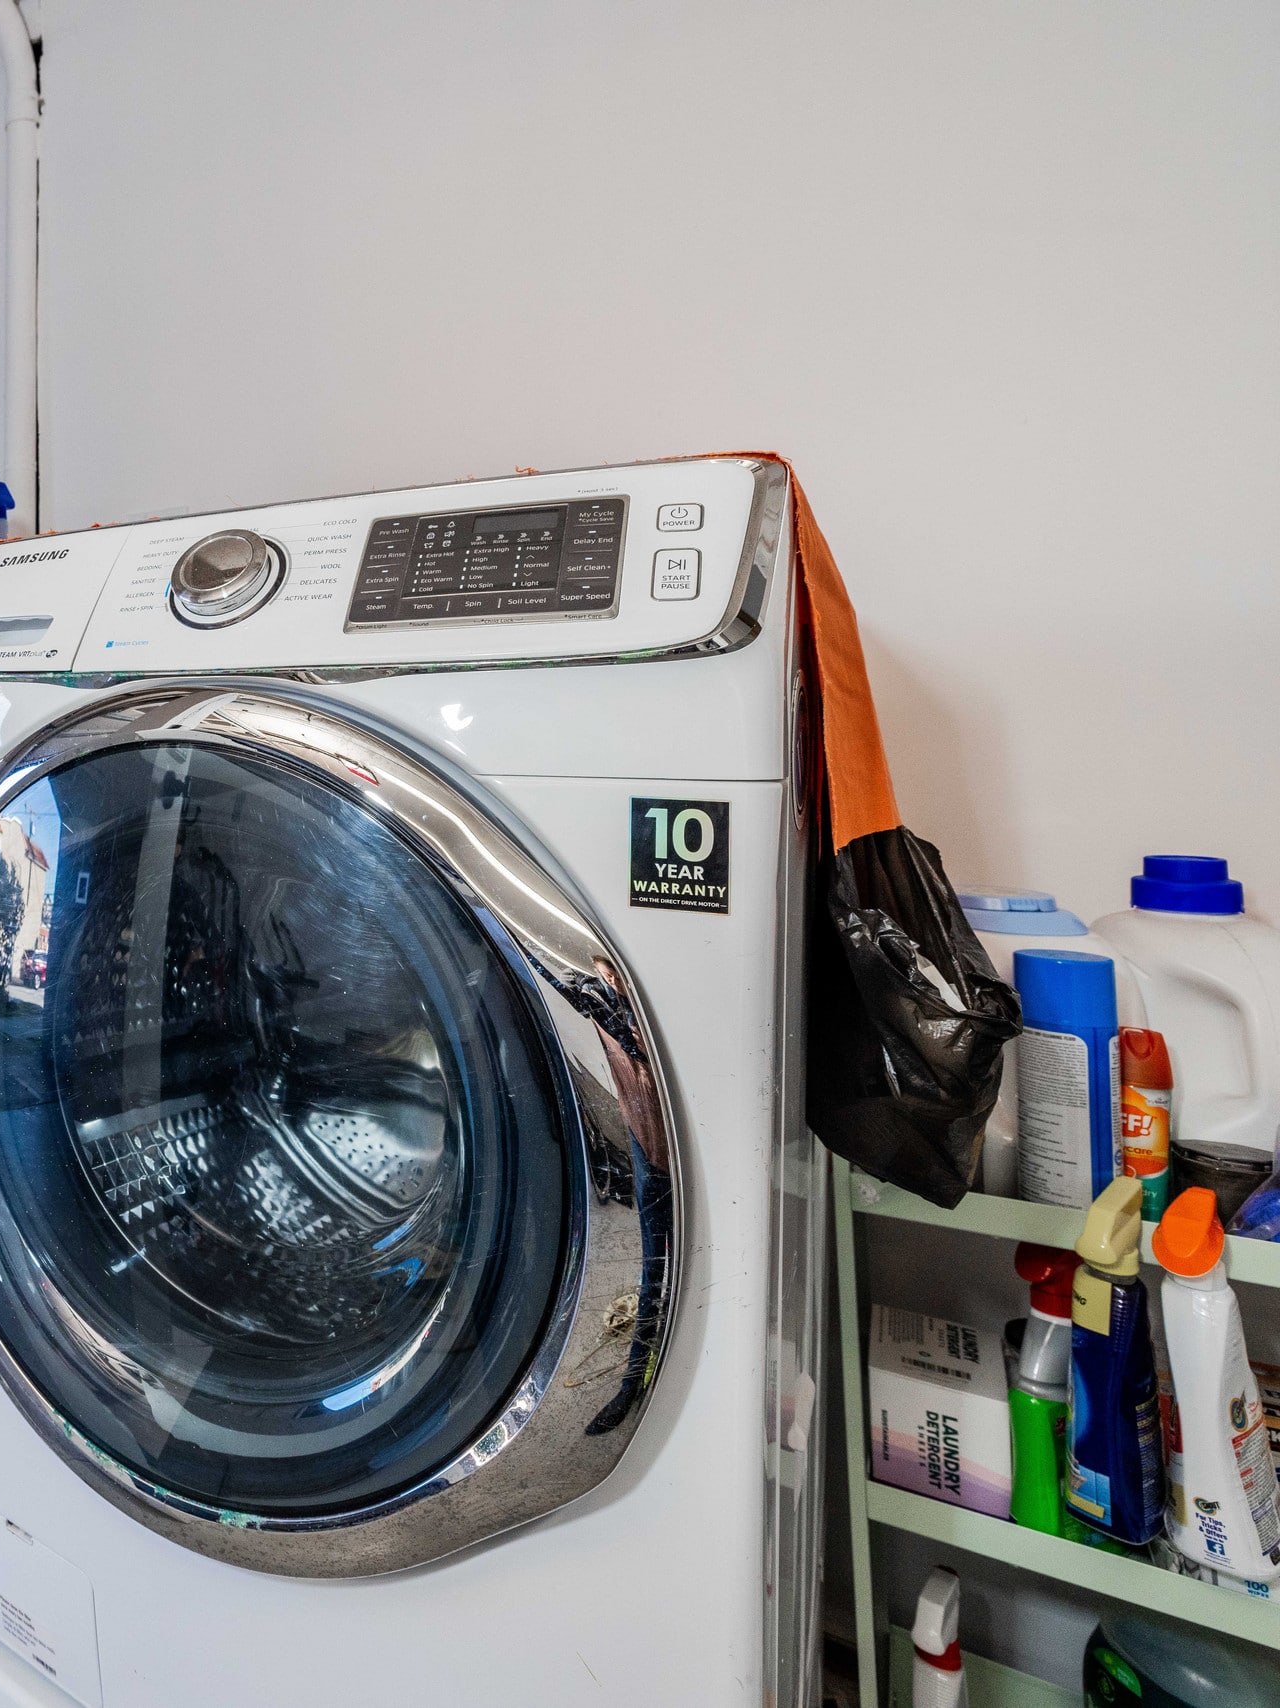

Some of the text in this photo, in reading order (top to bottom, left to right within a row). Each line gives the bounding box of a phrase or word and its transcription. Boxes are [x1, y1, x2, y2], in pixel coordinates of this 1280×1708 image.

[0, 548, 70, 568] SAMSUNG
[300, 578, 338, 586] DELICATES
[384, 576, 399, 584] Spin
[284, 594, 309, 602] ACTIVE
[644, 808, 714, 862] 10
[654, 863, 704, 880] YEAR
[633, 880, 726, 898] WARRANTY
[926, 1410, 942, 1489] DETERGENT
[942, 1414, 962, 1496] LAUNDRY
[1195, 1512, 1226, 1528] For Tips,
[1201, 1521, 1223, 1533] Tricks
[1206, 1528, 1228, 1540] Offers
[1244, 1580, 1270, 1593] 100
